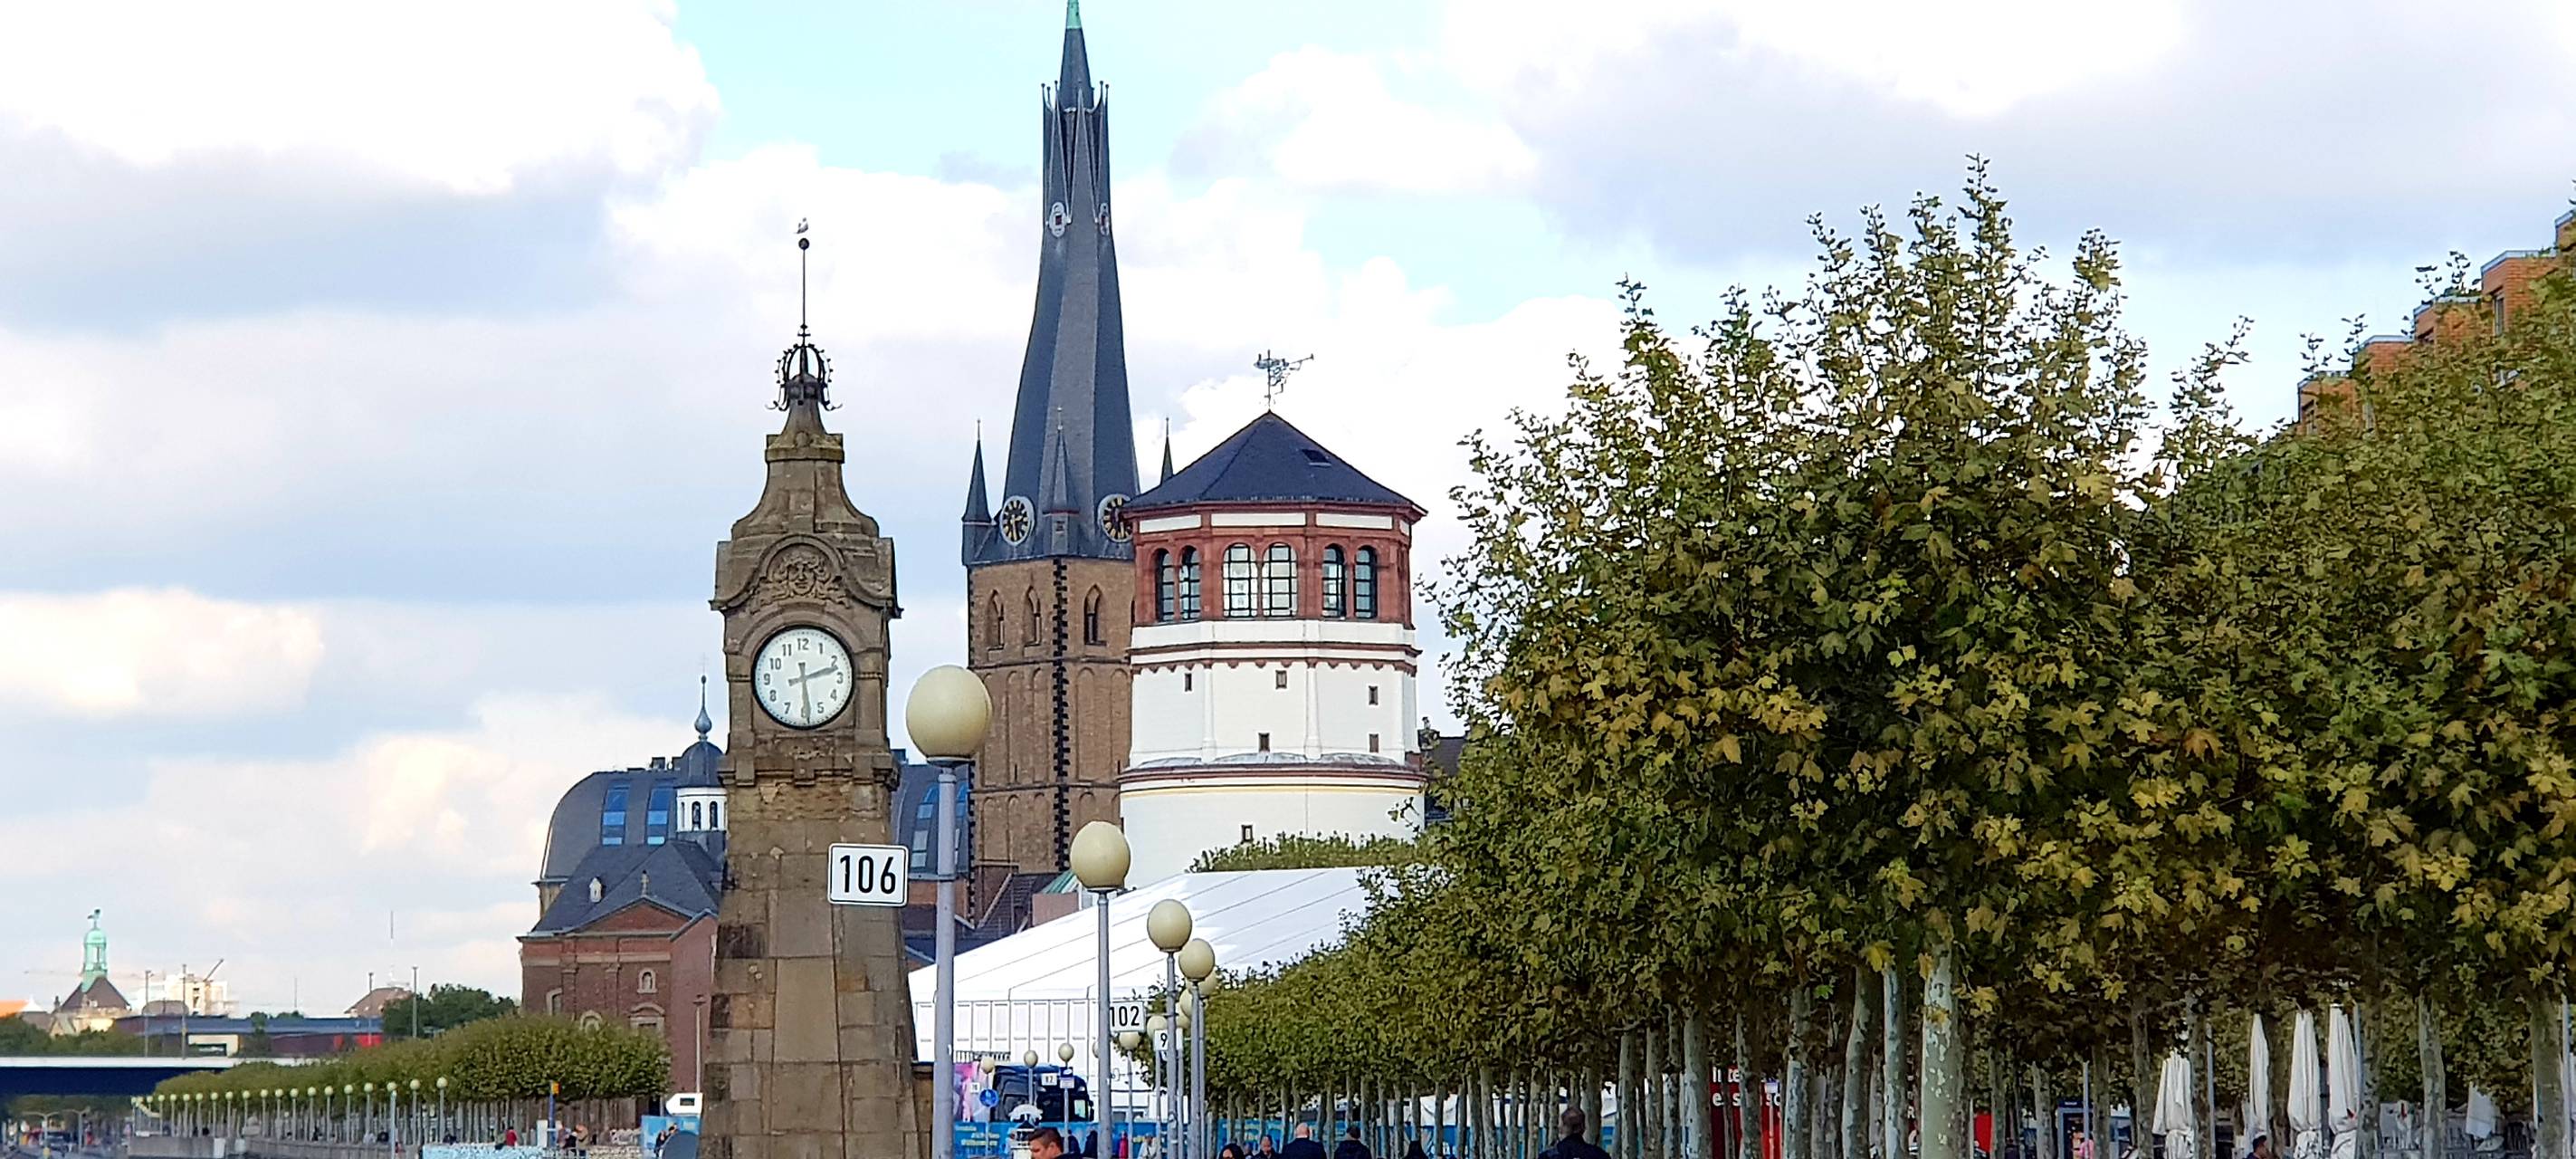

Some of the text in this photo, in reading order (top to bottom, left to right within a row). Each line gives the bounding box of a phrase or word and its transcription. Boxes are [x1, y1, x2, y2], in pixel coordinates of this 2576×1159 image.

[782, 644, 792, 656] 11
[797, 638, 809, 650] 12
[819, 643, 824, 655] 1
[769, 658, 781, 670] 10
[831, 656, 838, 667] 2
[763, 674, 770, 685] 9
[836, 672, 844, 684] 3
[769, 690, 777, 702] 8
[830, 689, 837, 701] 4
[784, 703, 791, 714] 7
[817, 702, 825, 714] 5
[840, 855, 896, 894] 106
[1110, 1005, 1140, 1027] 102
[1160, 1032, 1168, 1048] 9
